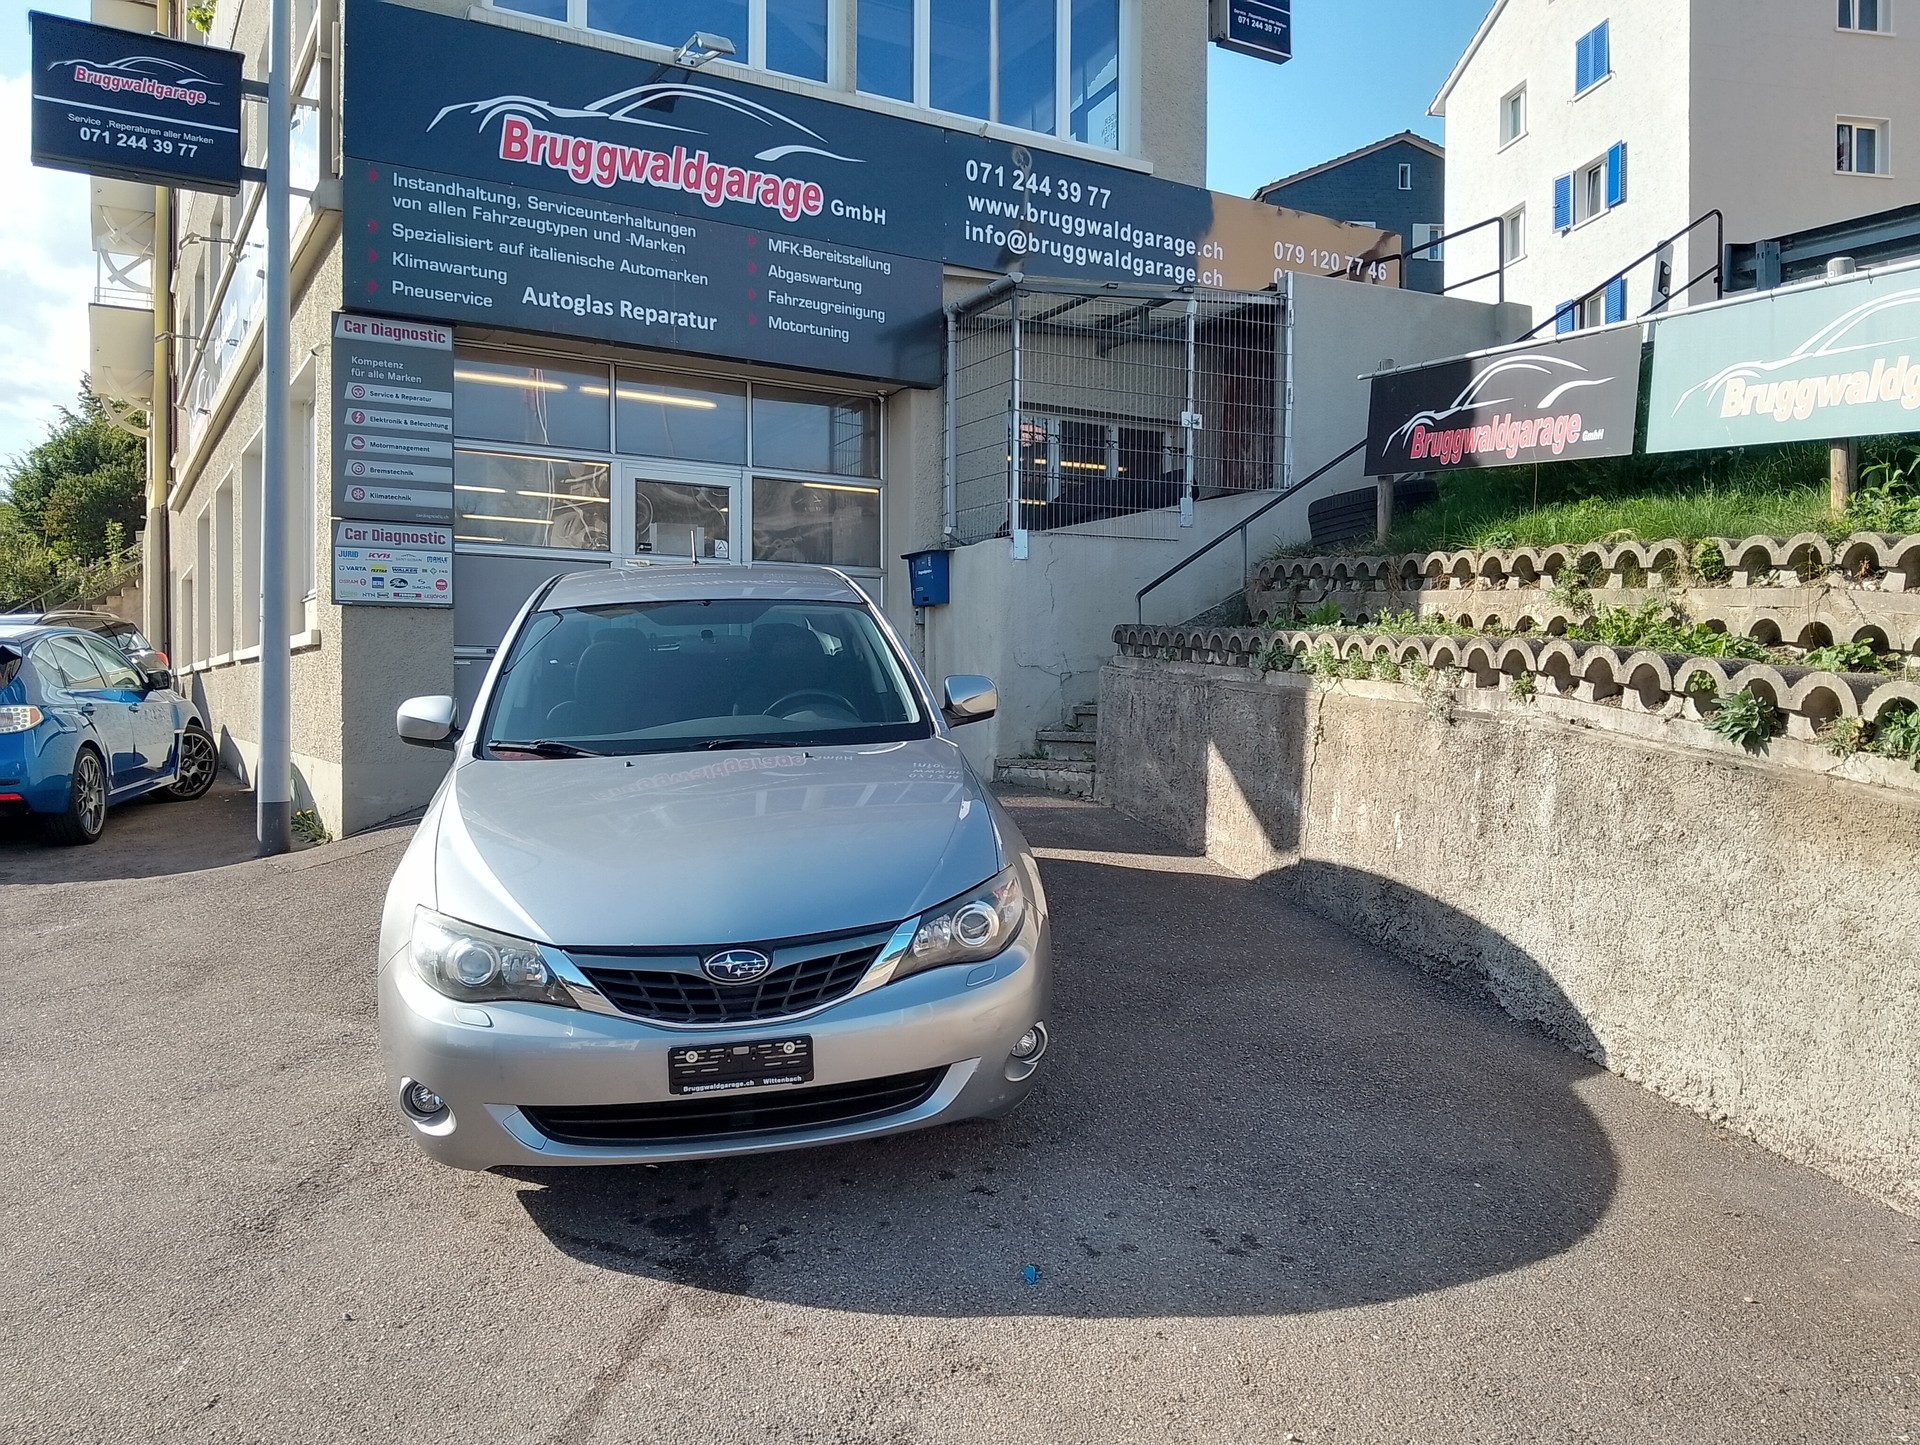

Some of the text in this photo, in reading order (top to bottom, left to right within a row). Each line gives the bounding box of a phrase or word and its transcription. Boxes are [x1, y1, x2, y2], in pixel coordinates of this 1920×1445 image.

[1237, 15, 1282, 35] 071 244 39 77
[74, 65, 207, 105] Bruggwaldgarage
[67, 113, 101, 126] Service
[163, 130, 182, 140] aller
[183, 132, 214, 145] Marken
[79, 127, 198, 158] 071 244 39 77
[500, 113, 886, 225] Bruggwaldgarage GmbH
[965, 159, 1111, 209] 071 244 39 77
[393, 172, 697, 238] Instandhaltung, Serviceunterhaltungen
[392, 196, 686, 255] von allen Fahrzeugtypen und -Marken
[968, 195, 1224, 261] www.bruggwaldgarage.ch
[392, 222, 708, 286] Spezialisiert auf italienische Automarken
[392, 251, 508, 285] Klimawartung
[768, 238, 891, 275] MFK-Bereitstellung
[965, 220, 1224, 287] info@bruggwaldgarage.ch
[1273, 241, 1387, 281] 079 120 77 46
[392, 280, 493, 307] Pneuservice
[768, 264, 862, 295] Abgaswartung
[521, 286, 718, 331] Autoglas Reparatur
[768, 290, 885, 324] Fahrzeugreinigung
[344, 320, 446, 344] Car Diagnostic
[768, 315, 850, 343] Motortuning
[351, 355, 404, 370] Kompetenz
[351, 367, 422, 384] für alle Marken
[369, 390, 394, 399] Service
[401, 393, 432, 403] Reparatur
[369, 415, 403, 425] Elektronik
[409, 419, 449, 431] Beleuchtung
[369, 441, 431, 453] Motormanagement
[1410, 413, 1605, 466] Bruggwaldgarage GmbH
[369, 467, 415, 477] Bremstechnik
[369, 493, 412, 502] Klimatechnik
[344, 527, 446, 546] Car Diagnostic
[338, 550, 359, 558] JURID
[683, 1075, 802, 1093] Bruggwaldgarage.ch Wittenbach
